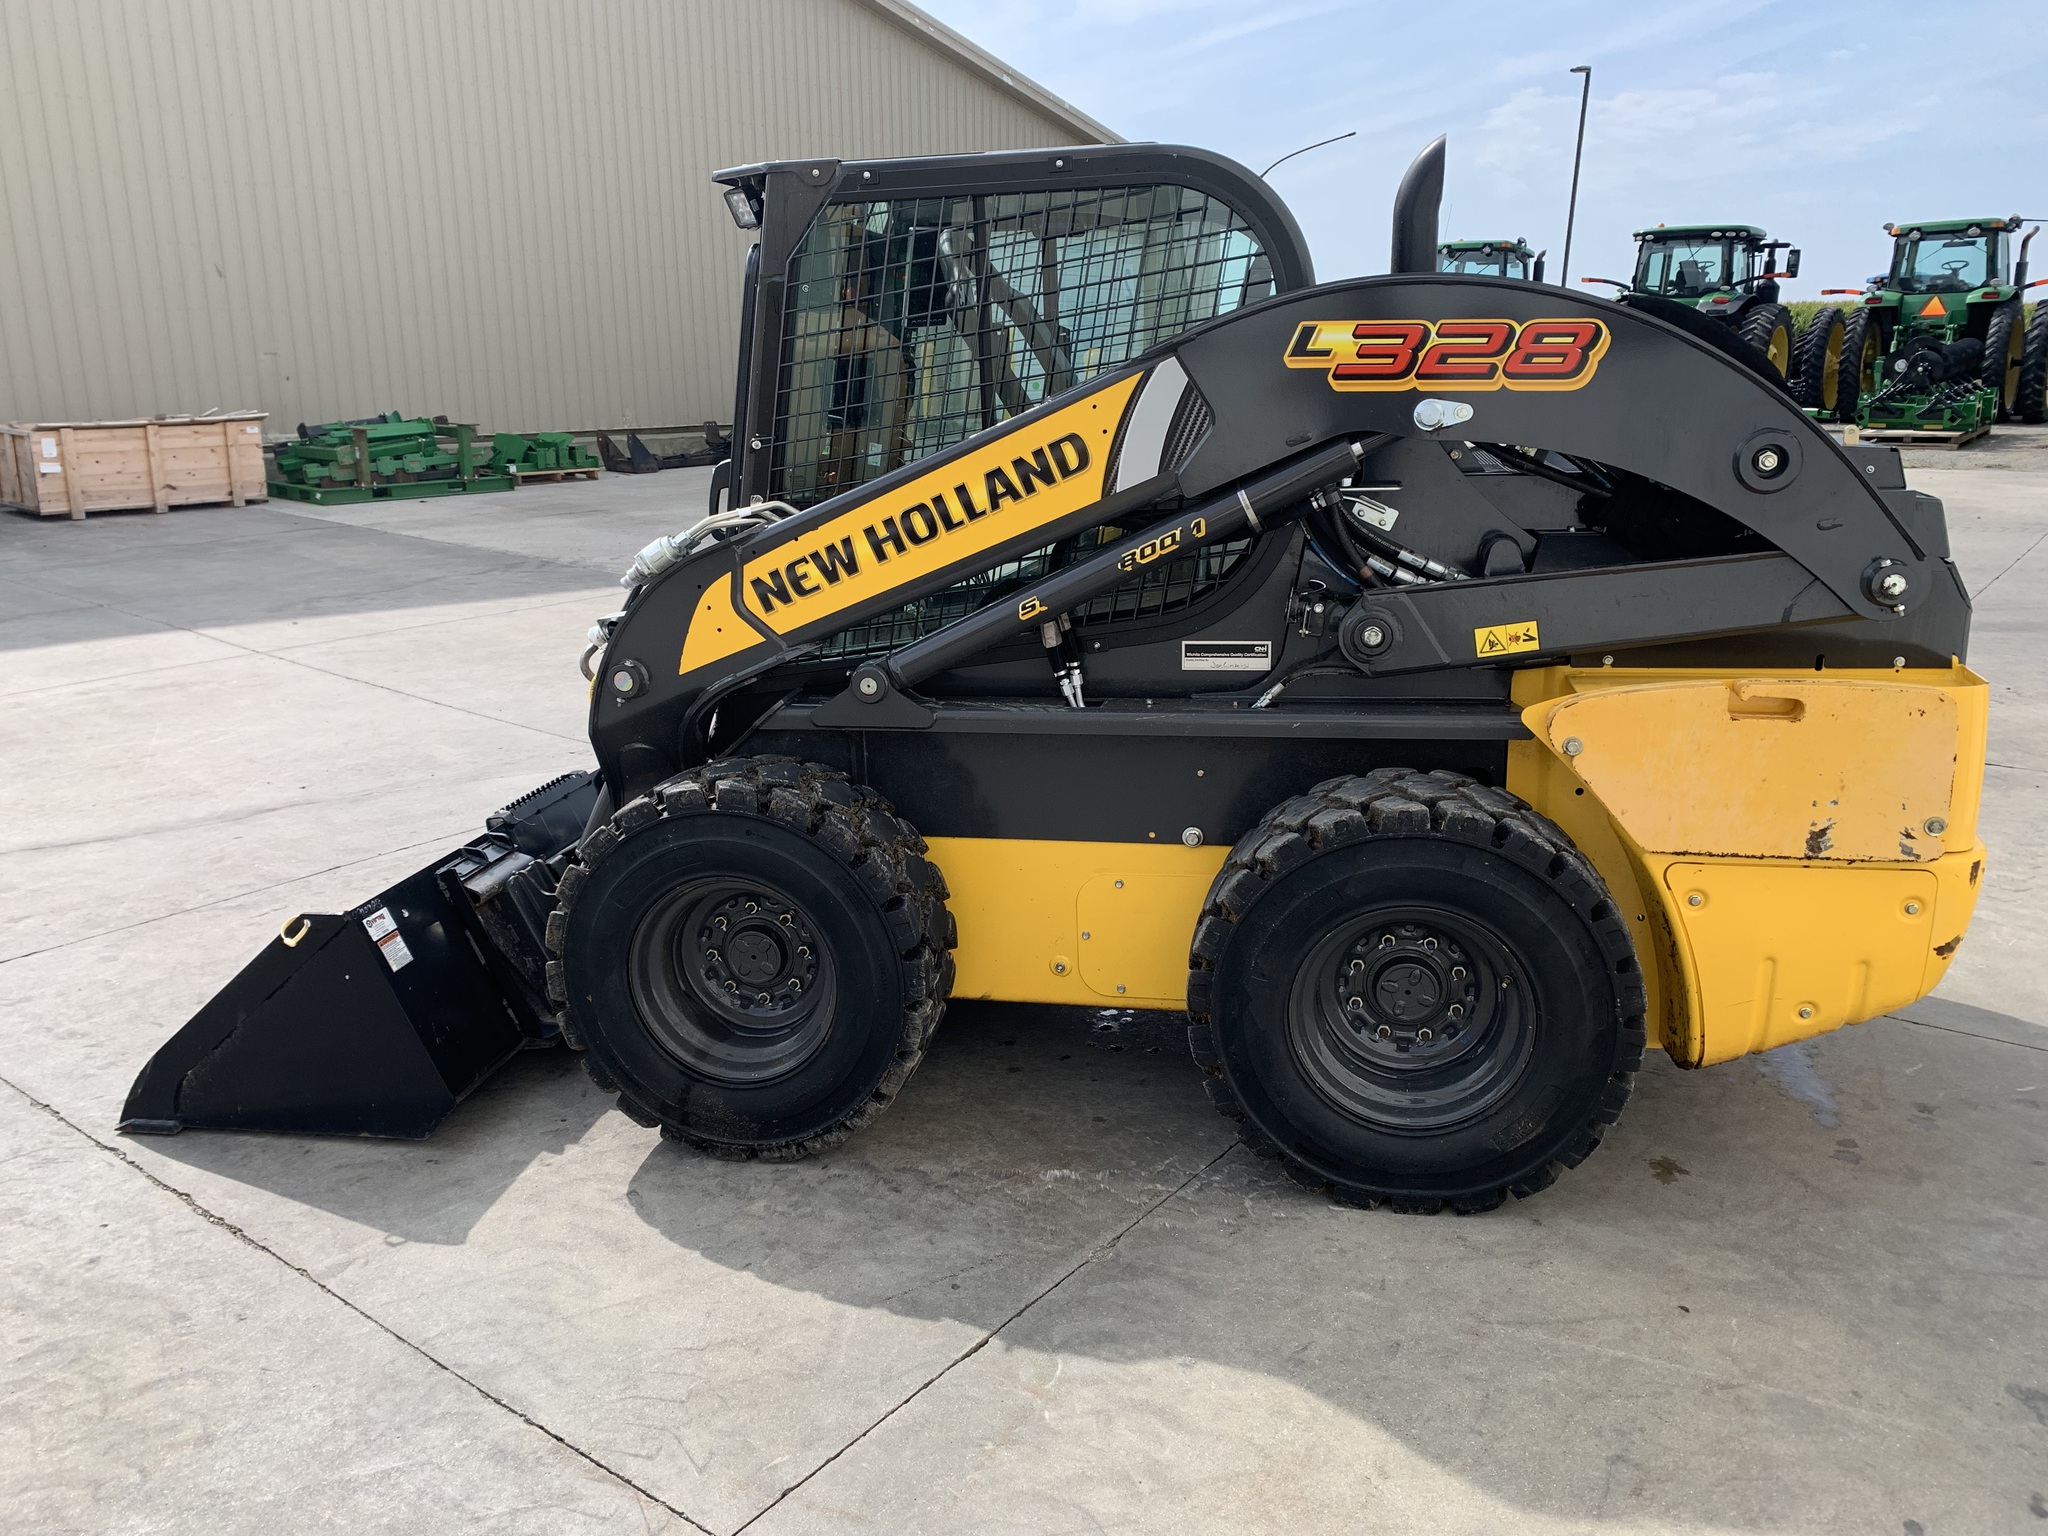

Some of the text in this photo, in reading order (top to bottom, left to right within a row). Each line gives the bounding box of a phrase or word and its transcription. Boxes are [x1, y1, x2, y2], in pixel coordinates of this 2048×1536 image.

[1284, 319, 1611, 391] L328
[749, 431, 1092, 615] NEW HOLLAND
